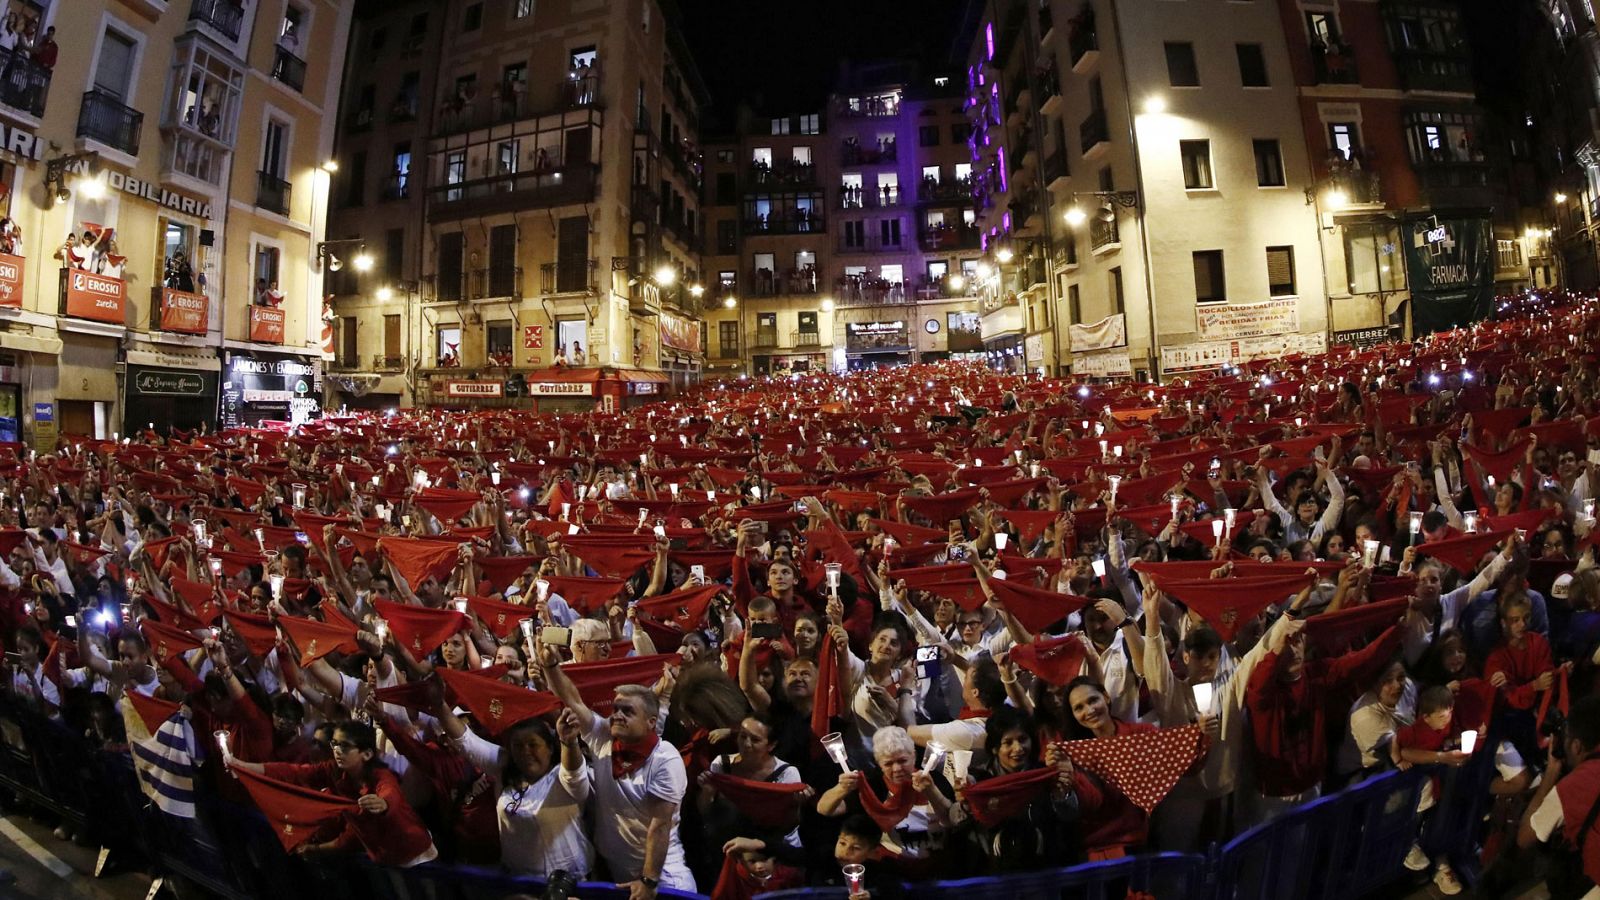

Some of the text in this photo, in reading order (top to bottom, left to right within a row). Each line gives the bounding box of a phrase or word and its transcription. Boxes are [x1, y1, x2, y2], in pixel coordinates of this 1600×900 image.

[0, 122, 44, 161] RI
[1431, 264, 1469, 285] FARMACIA
[88, 280, 119, 295] EROSKI
[177, 297, 203, 309] EROSKI
[1199, 300, 1296, 314] BOCADILLOS CALIENTES
[262, 312, 282, 322] EROSKI
[1219, 317, 1257, 326] BEBIDAS
[1337, 329, 1389, 342] GUTIERREZ
[232, 359, 267, 373] JAMONES
[268, 362, 275, 373] Y
[82, 378, 89, 391] 2
[456, 384, 494, 393] GUTIERREZ
[539, 384, 584, 393] GUTIERREZ
